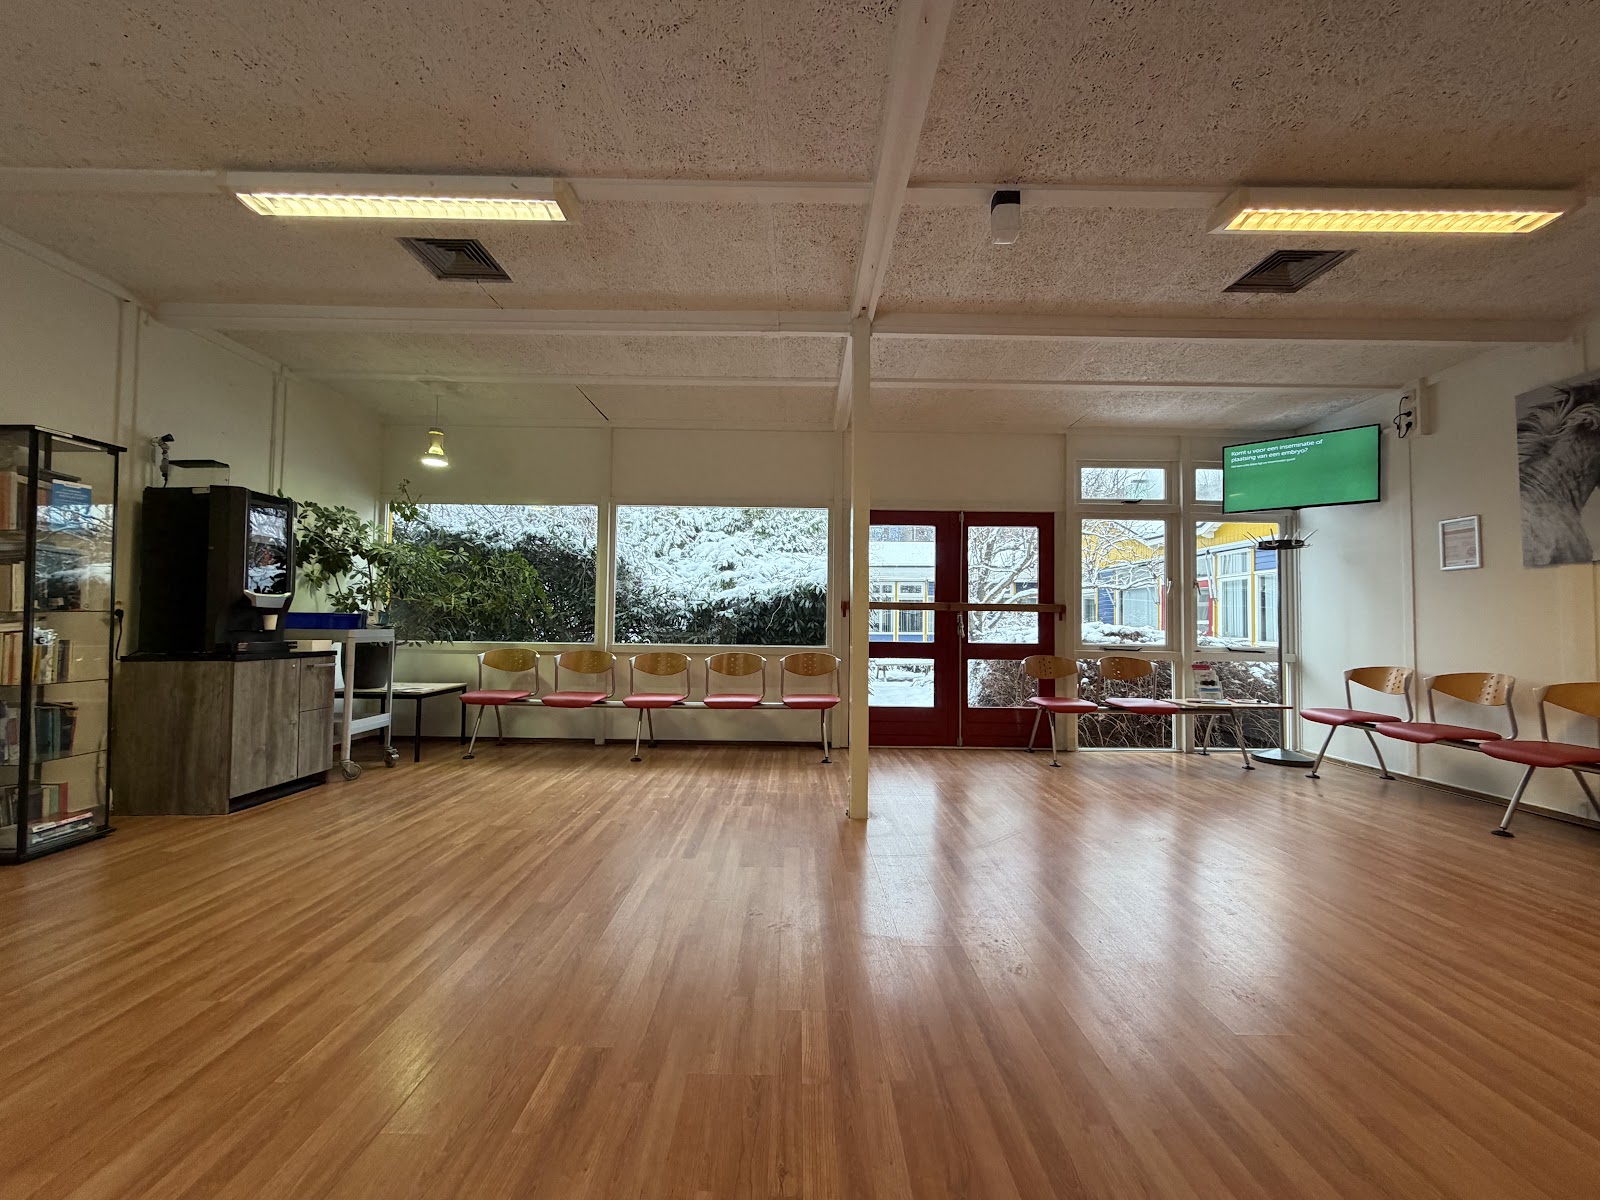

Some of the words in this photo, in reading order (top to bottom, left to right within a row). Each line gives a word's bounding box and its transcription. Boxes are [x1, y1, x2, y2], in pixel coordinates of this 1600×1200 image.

[1280, 440, 1315, 450] inseminatie
[1231, 455, 1256, 464] plaatsing
[1281, 447, 1308, 456] embryo?
